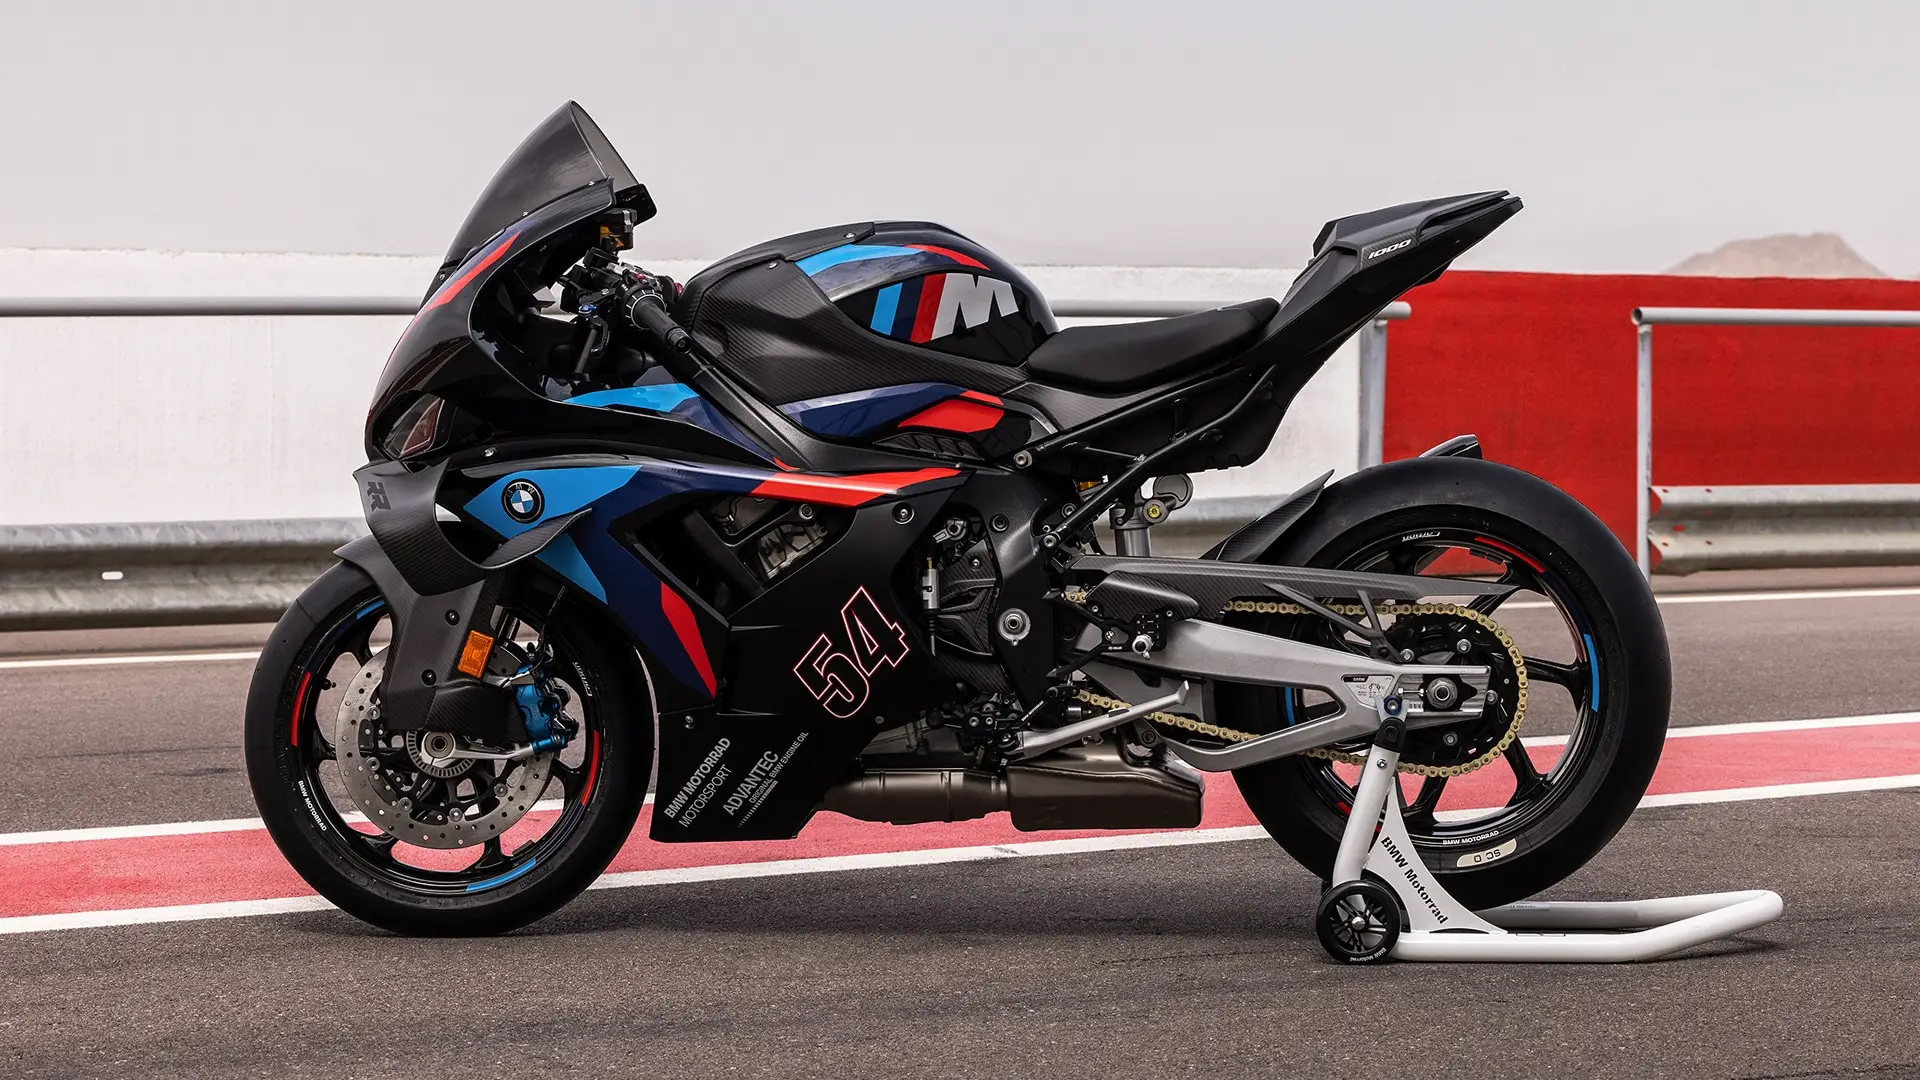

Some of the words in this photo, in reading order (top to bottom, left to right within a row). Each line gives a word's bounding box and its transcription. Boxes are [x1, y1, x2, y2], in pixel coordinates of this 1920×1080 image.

[1368, 239, 1412, 259] 1000
[931, 273, 1019, 341] M
[793, 585, 909, 718] 54
[664, 791, 689, 818] BMW
[683, 737, 731, 795] MOTORRAD
[678, 764, 732, 827] MOTORSPORT
[722, 750, 779, 816] ADVANTEC
[749, 777, 773, 804] ORIGINAL
[769, 762, 784, 778] BMW
[780, 741, 801, 764] ENGINE
[796, 731, 809, 743] OIL
[298, 780, 308, 797] BMW
[304, 797, 327, 831] MOTORRAD
[1461, 830, 1499, 844] MOTORRAD
[1381, 836, 1408, 868] BMW
[1404, 868, 1449, 924] Motorrad
[1485, 849, 1501, 860] SC
